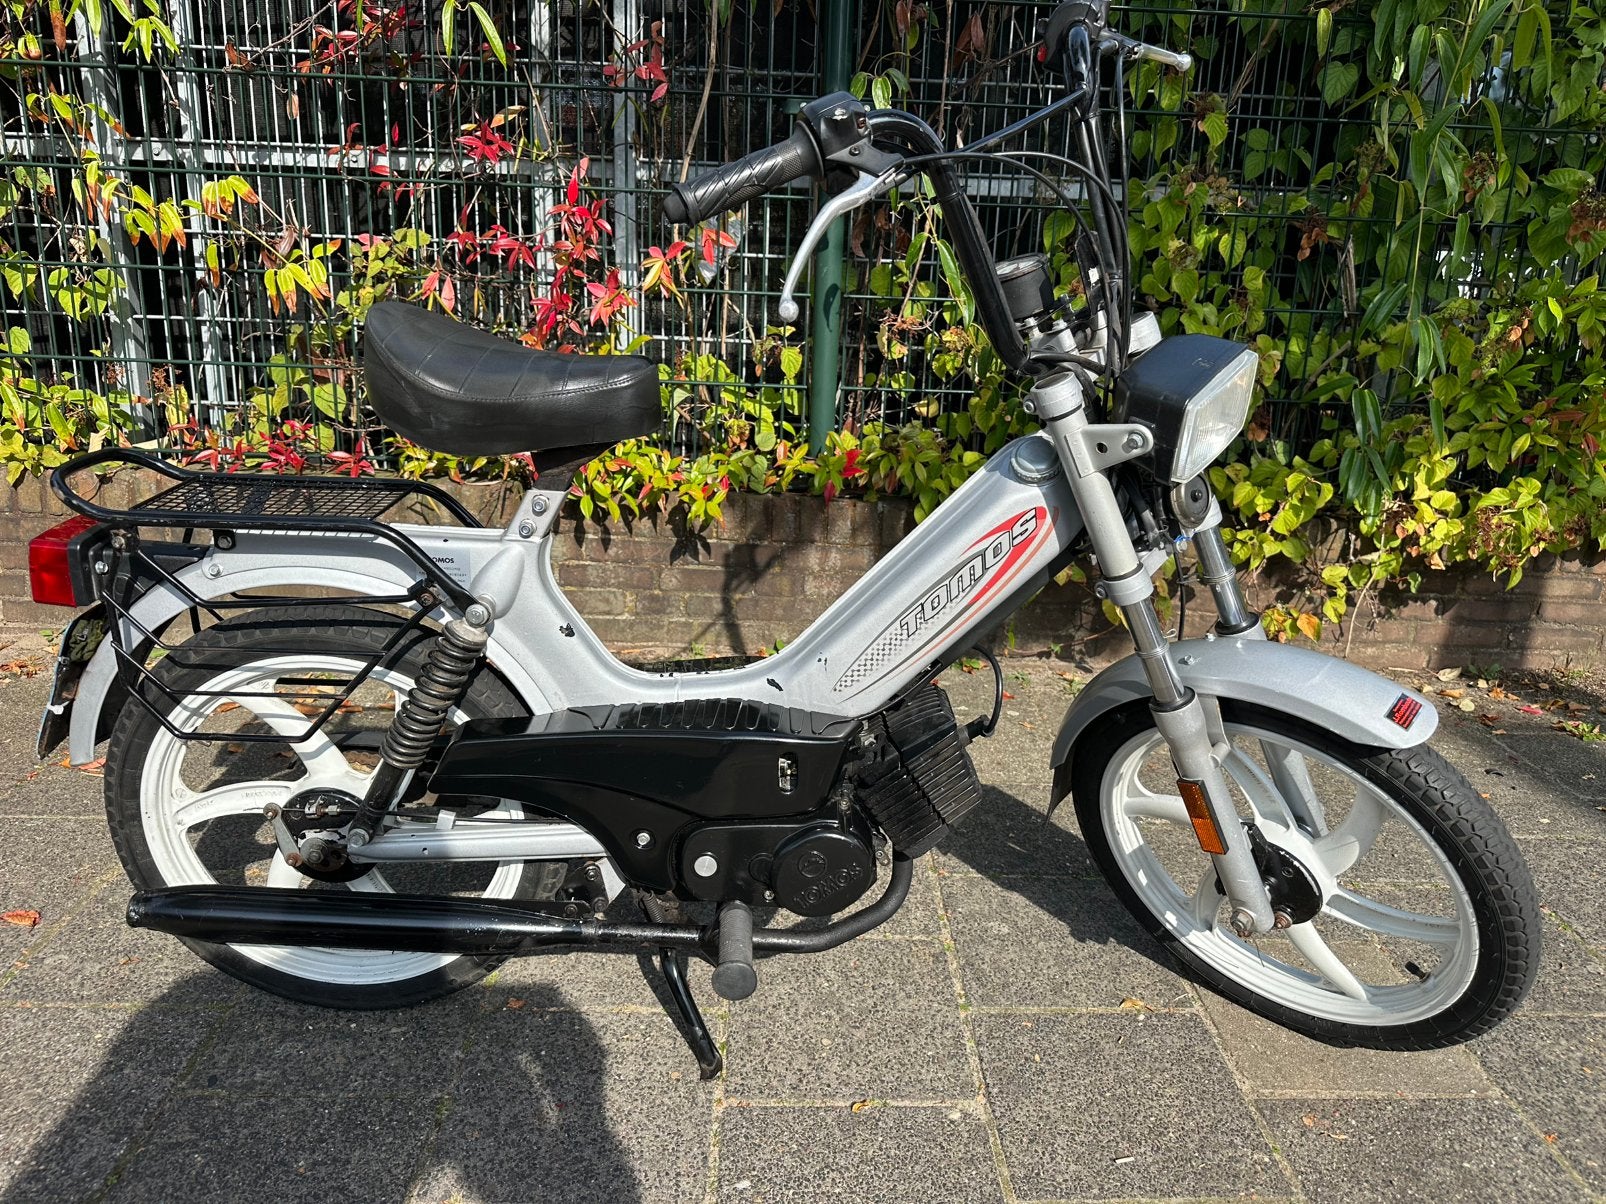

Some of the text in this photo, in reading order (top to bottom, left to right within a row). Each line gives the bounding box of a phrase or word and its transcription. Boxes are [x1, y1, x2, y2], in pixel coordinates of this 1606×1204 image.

[430, 556, 455, 564] OMOS
[900, 506, 1038, 637] TOMOS
[793, 861, 862, 909] TOMOS
